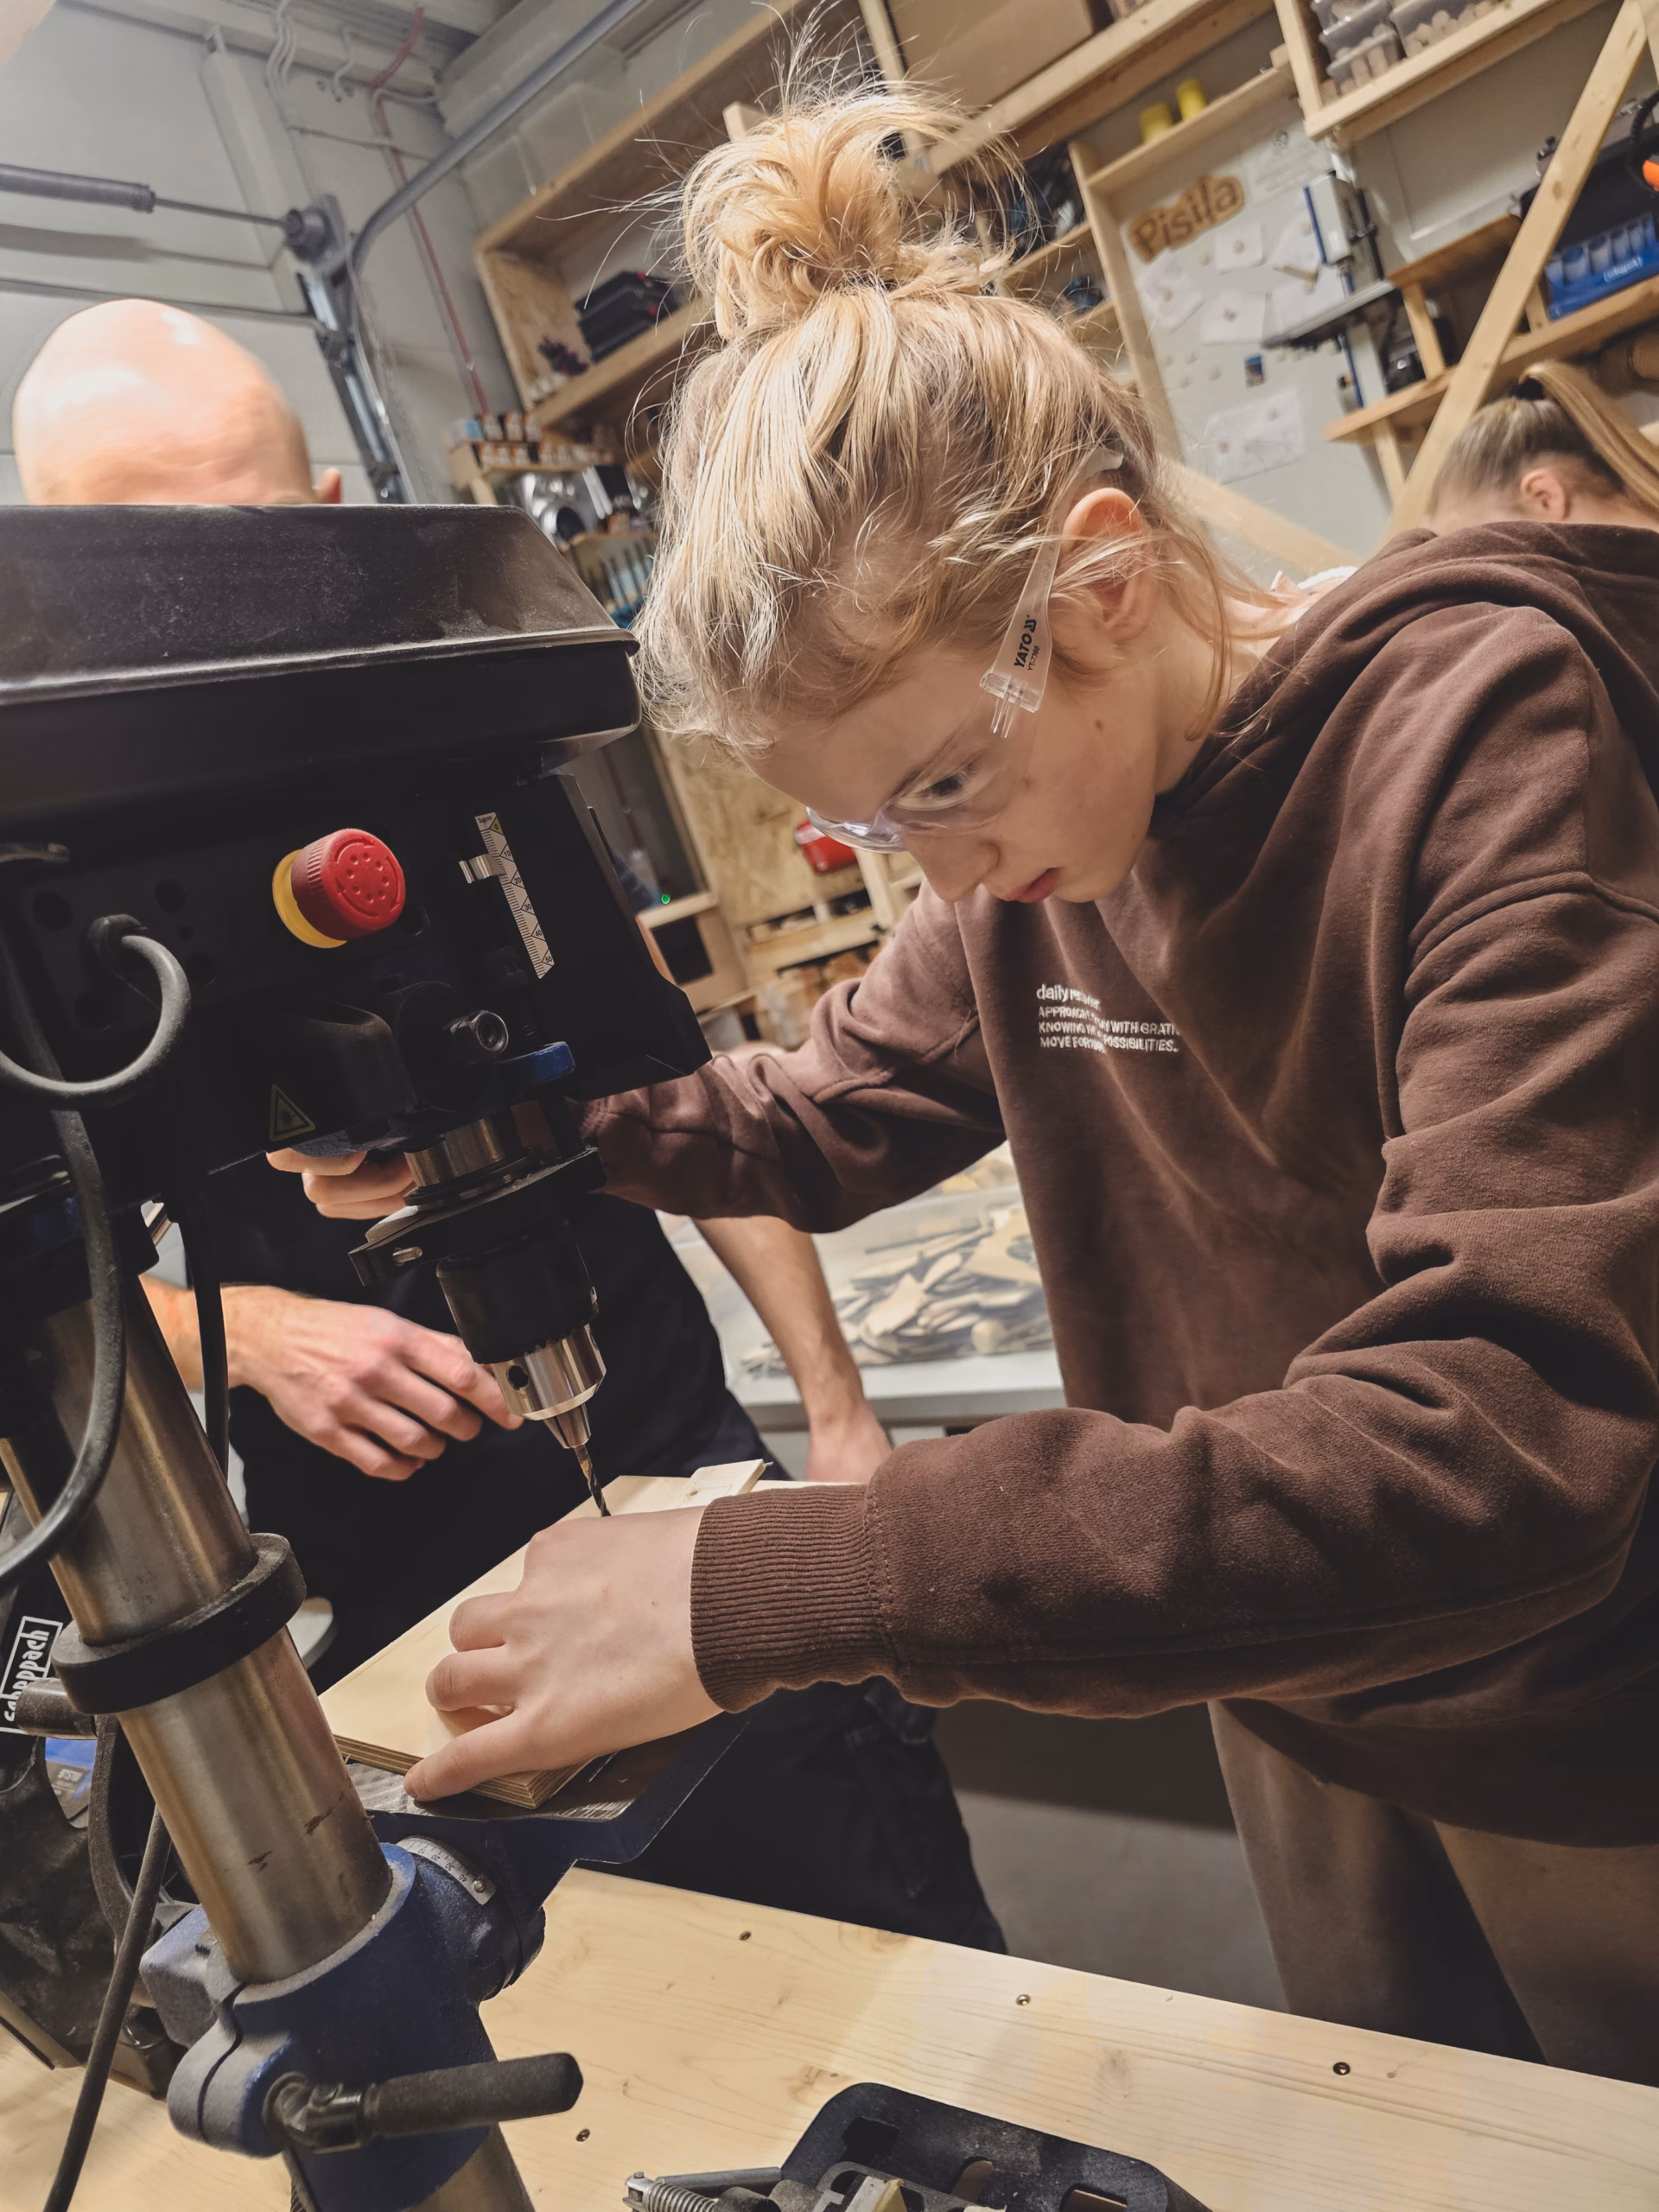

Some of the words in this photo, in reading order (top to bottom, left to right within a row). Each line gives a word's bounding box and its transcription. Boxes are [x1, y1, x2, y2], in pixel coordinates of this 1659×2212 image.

[1134, 179, 1238, 256] Pisila
[1014, 633, 1032, 668] YATO
[1036, 983, 1069, 1002] daily
[1110, 1020, 1138, 1034] WITH
[1141, 1023, 1179, 1035] GRATI
[1039, 1037, 1071, 1048] MOVE
